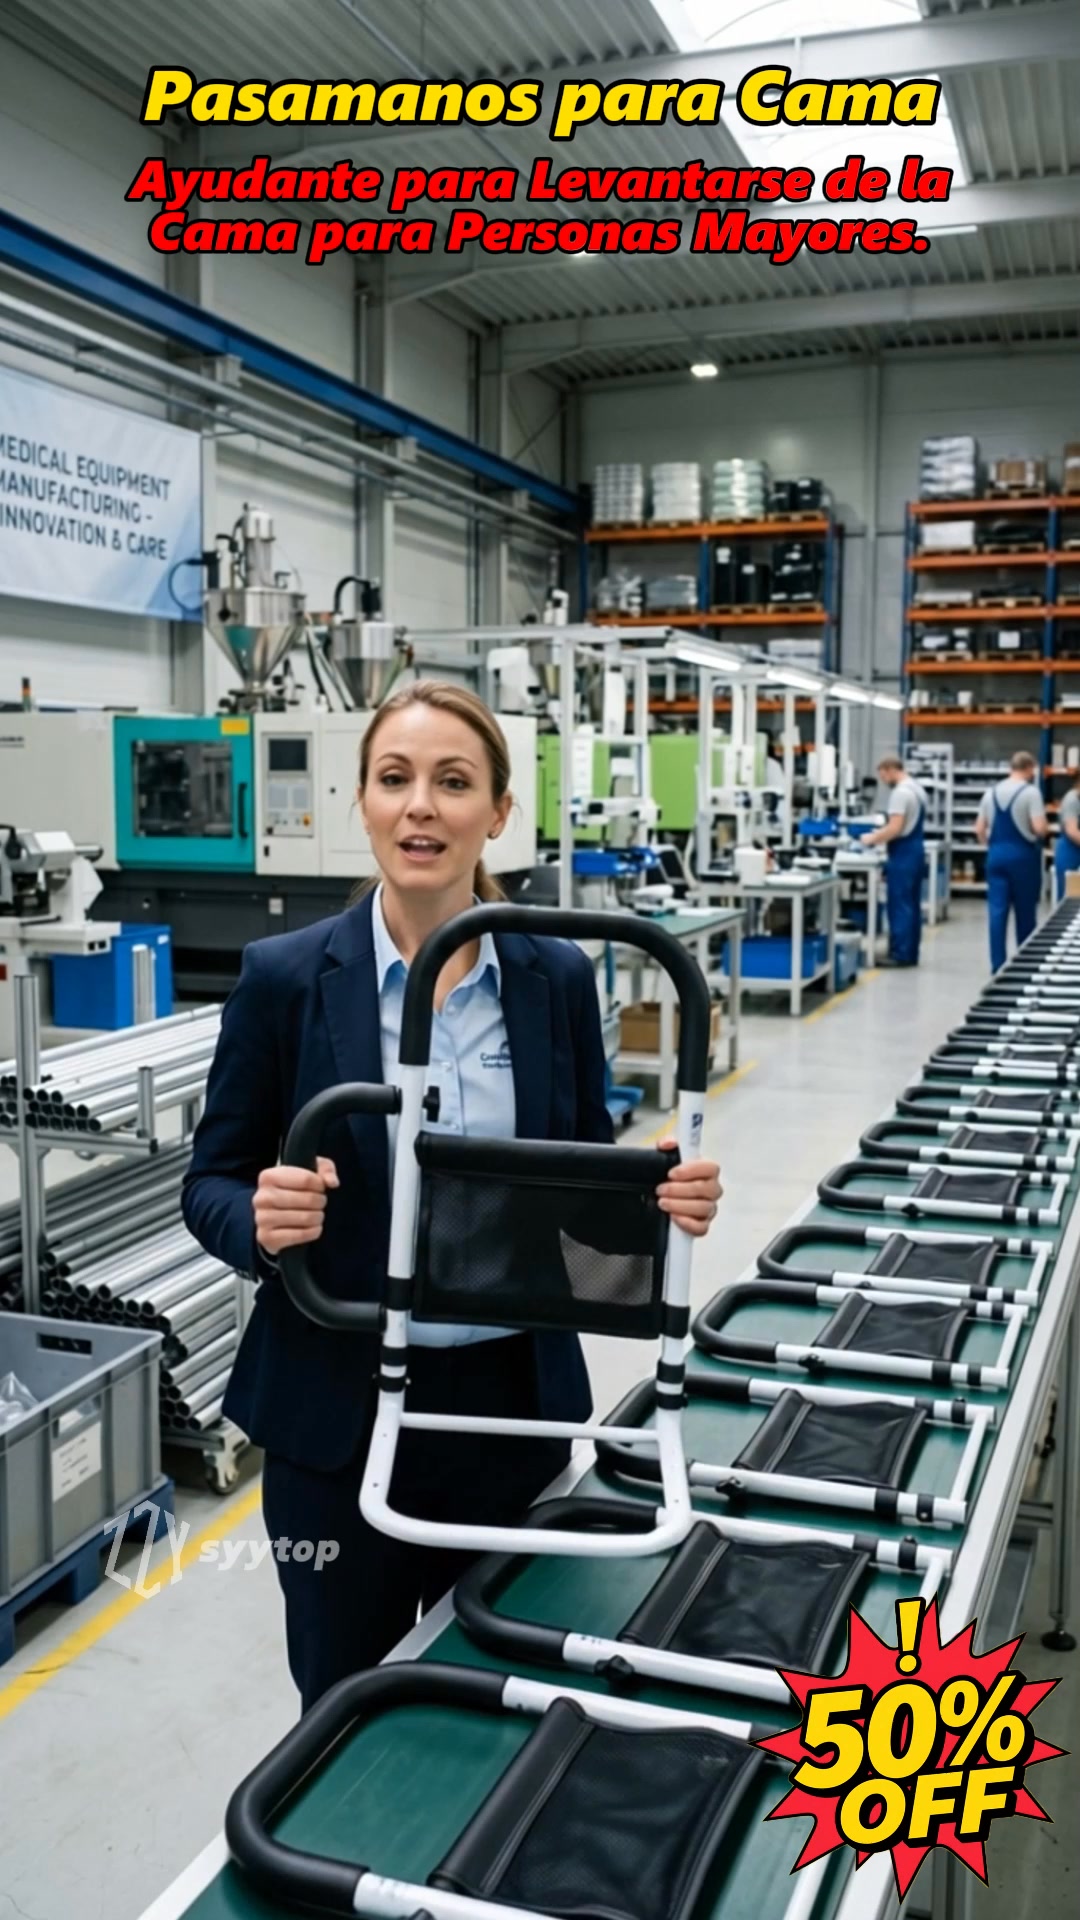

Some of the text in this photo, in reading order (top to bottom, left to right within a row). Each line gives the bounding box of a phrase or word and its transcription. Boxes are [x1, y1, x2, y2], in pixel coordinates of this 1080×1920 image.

[76, 456, 171, 501] EQUIPMENT
[0, 503, 168, 561] INNOVATION & CARE
